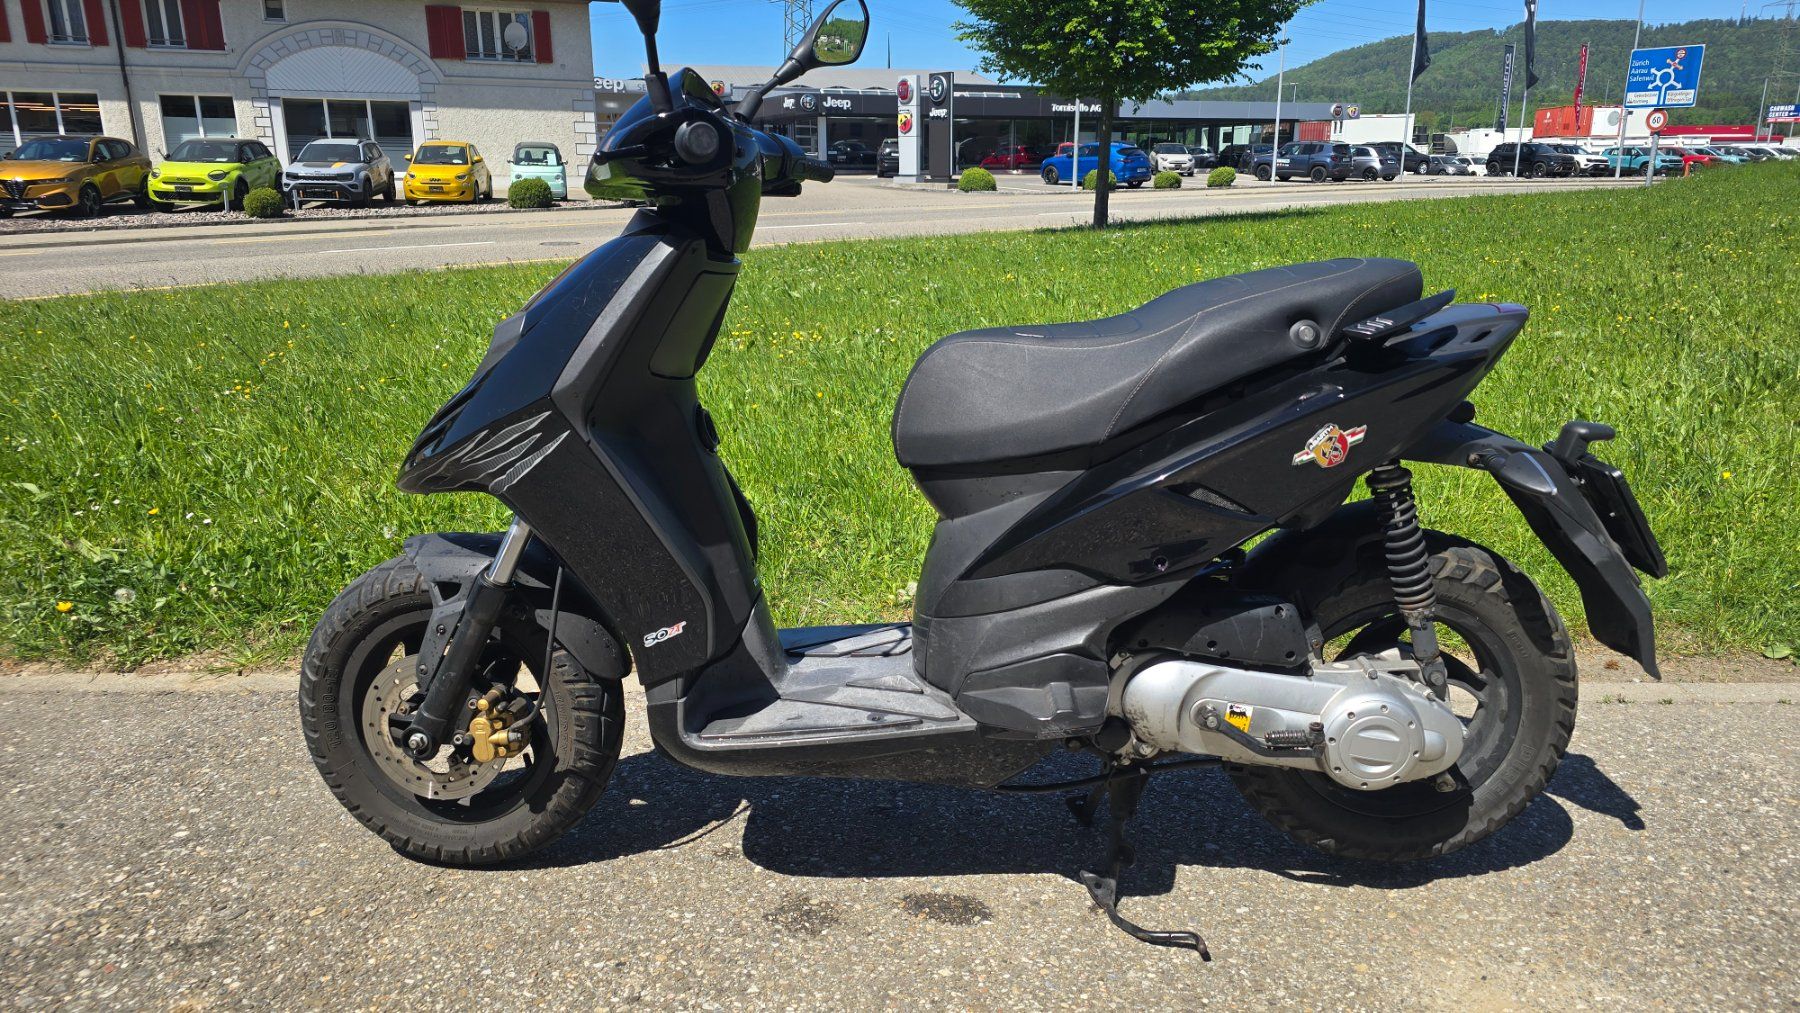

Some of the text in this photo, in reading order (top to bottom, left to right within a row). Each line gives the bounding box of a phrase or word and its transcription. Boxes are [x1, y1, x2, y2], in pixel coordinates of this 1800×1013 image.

[594, 77, 625, 93] eep
[822, 96, 852, 110] Jeep
[1089, 103, 1102, 113] AG
[929, 107, 948, 118] Jeep
[1651, 116, 1661, 124] 60
